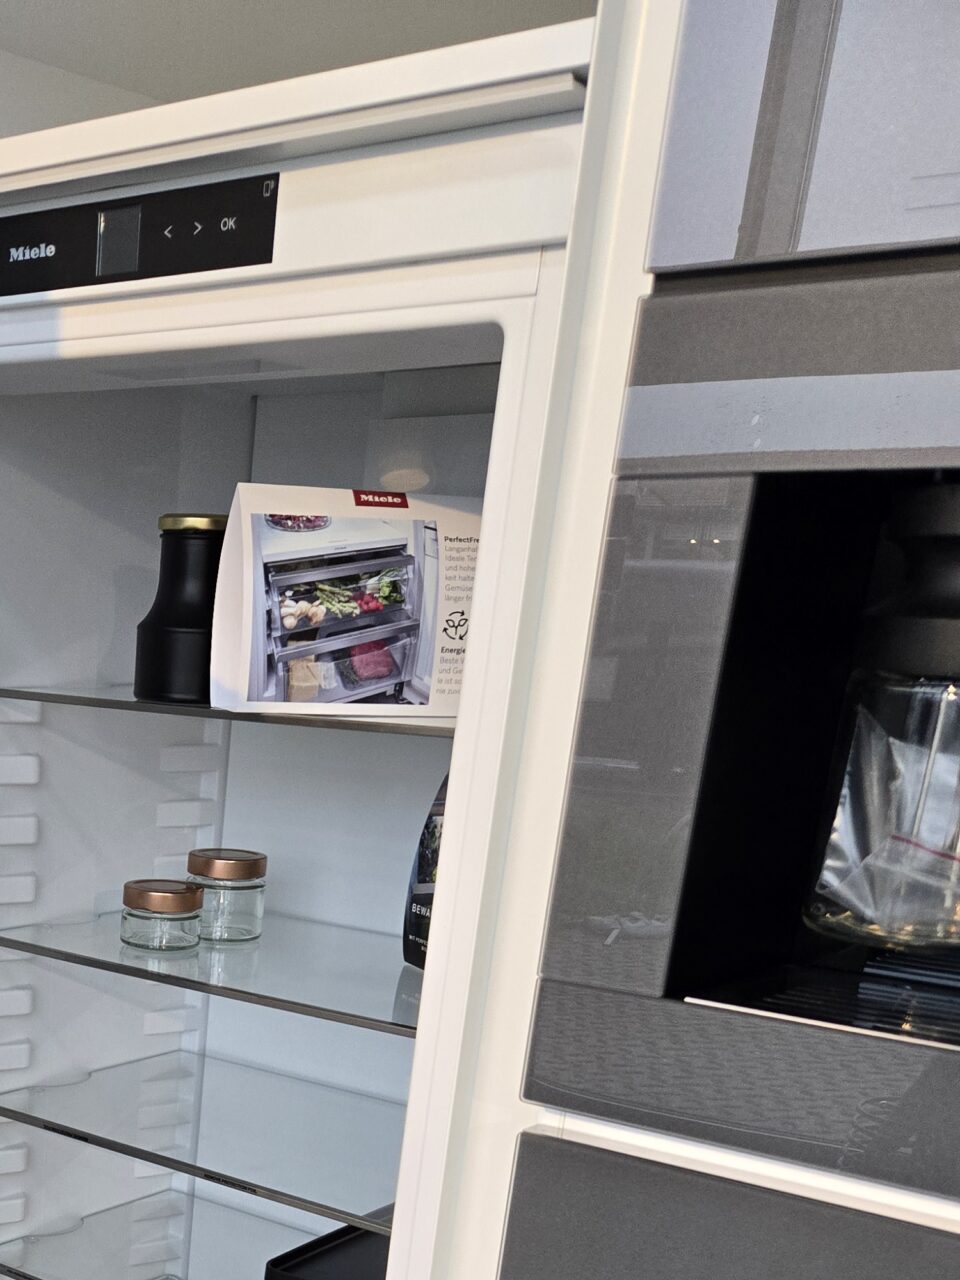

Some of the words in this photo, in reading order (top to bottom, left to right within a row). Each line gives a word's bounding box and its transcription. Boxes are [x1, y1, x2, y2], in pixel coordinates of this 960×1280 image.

[220, 217, 237, 231] OK
[9, 243, 56, 262] Miele
[360, 494, 402, 504] Miele
